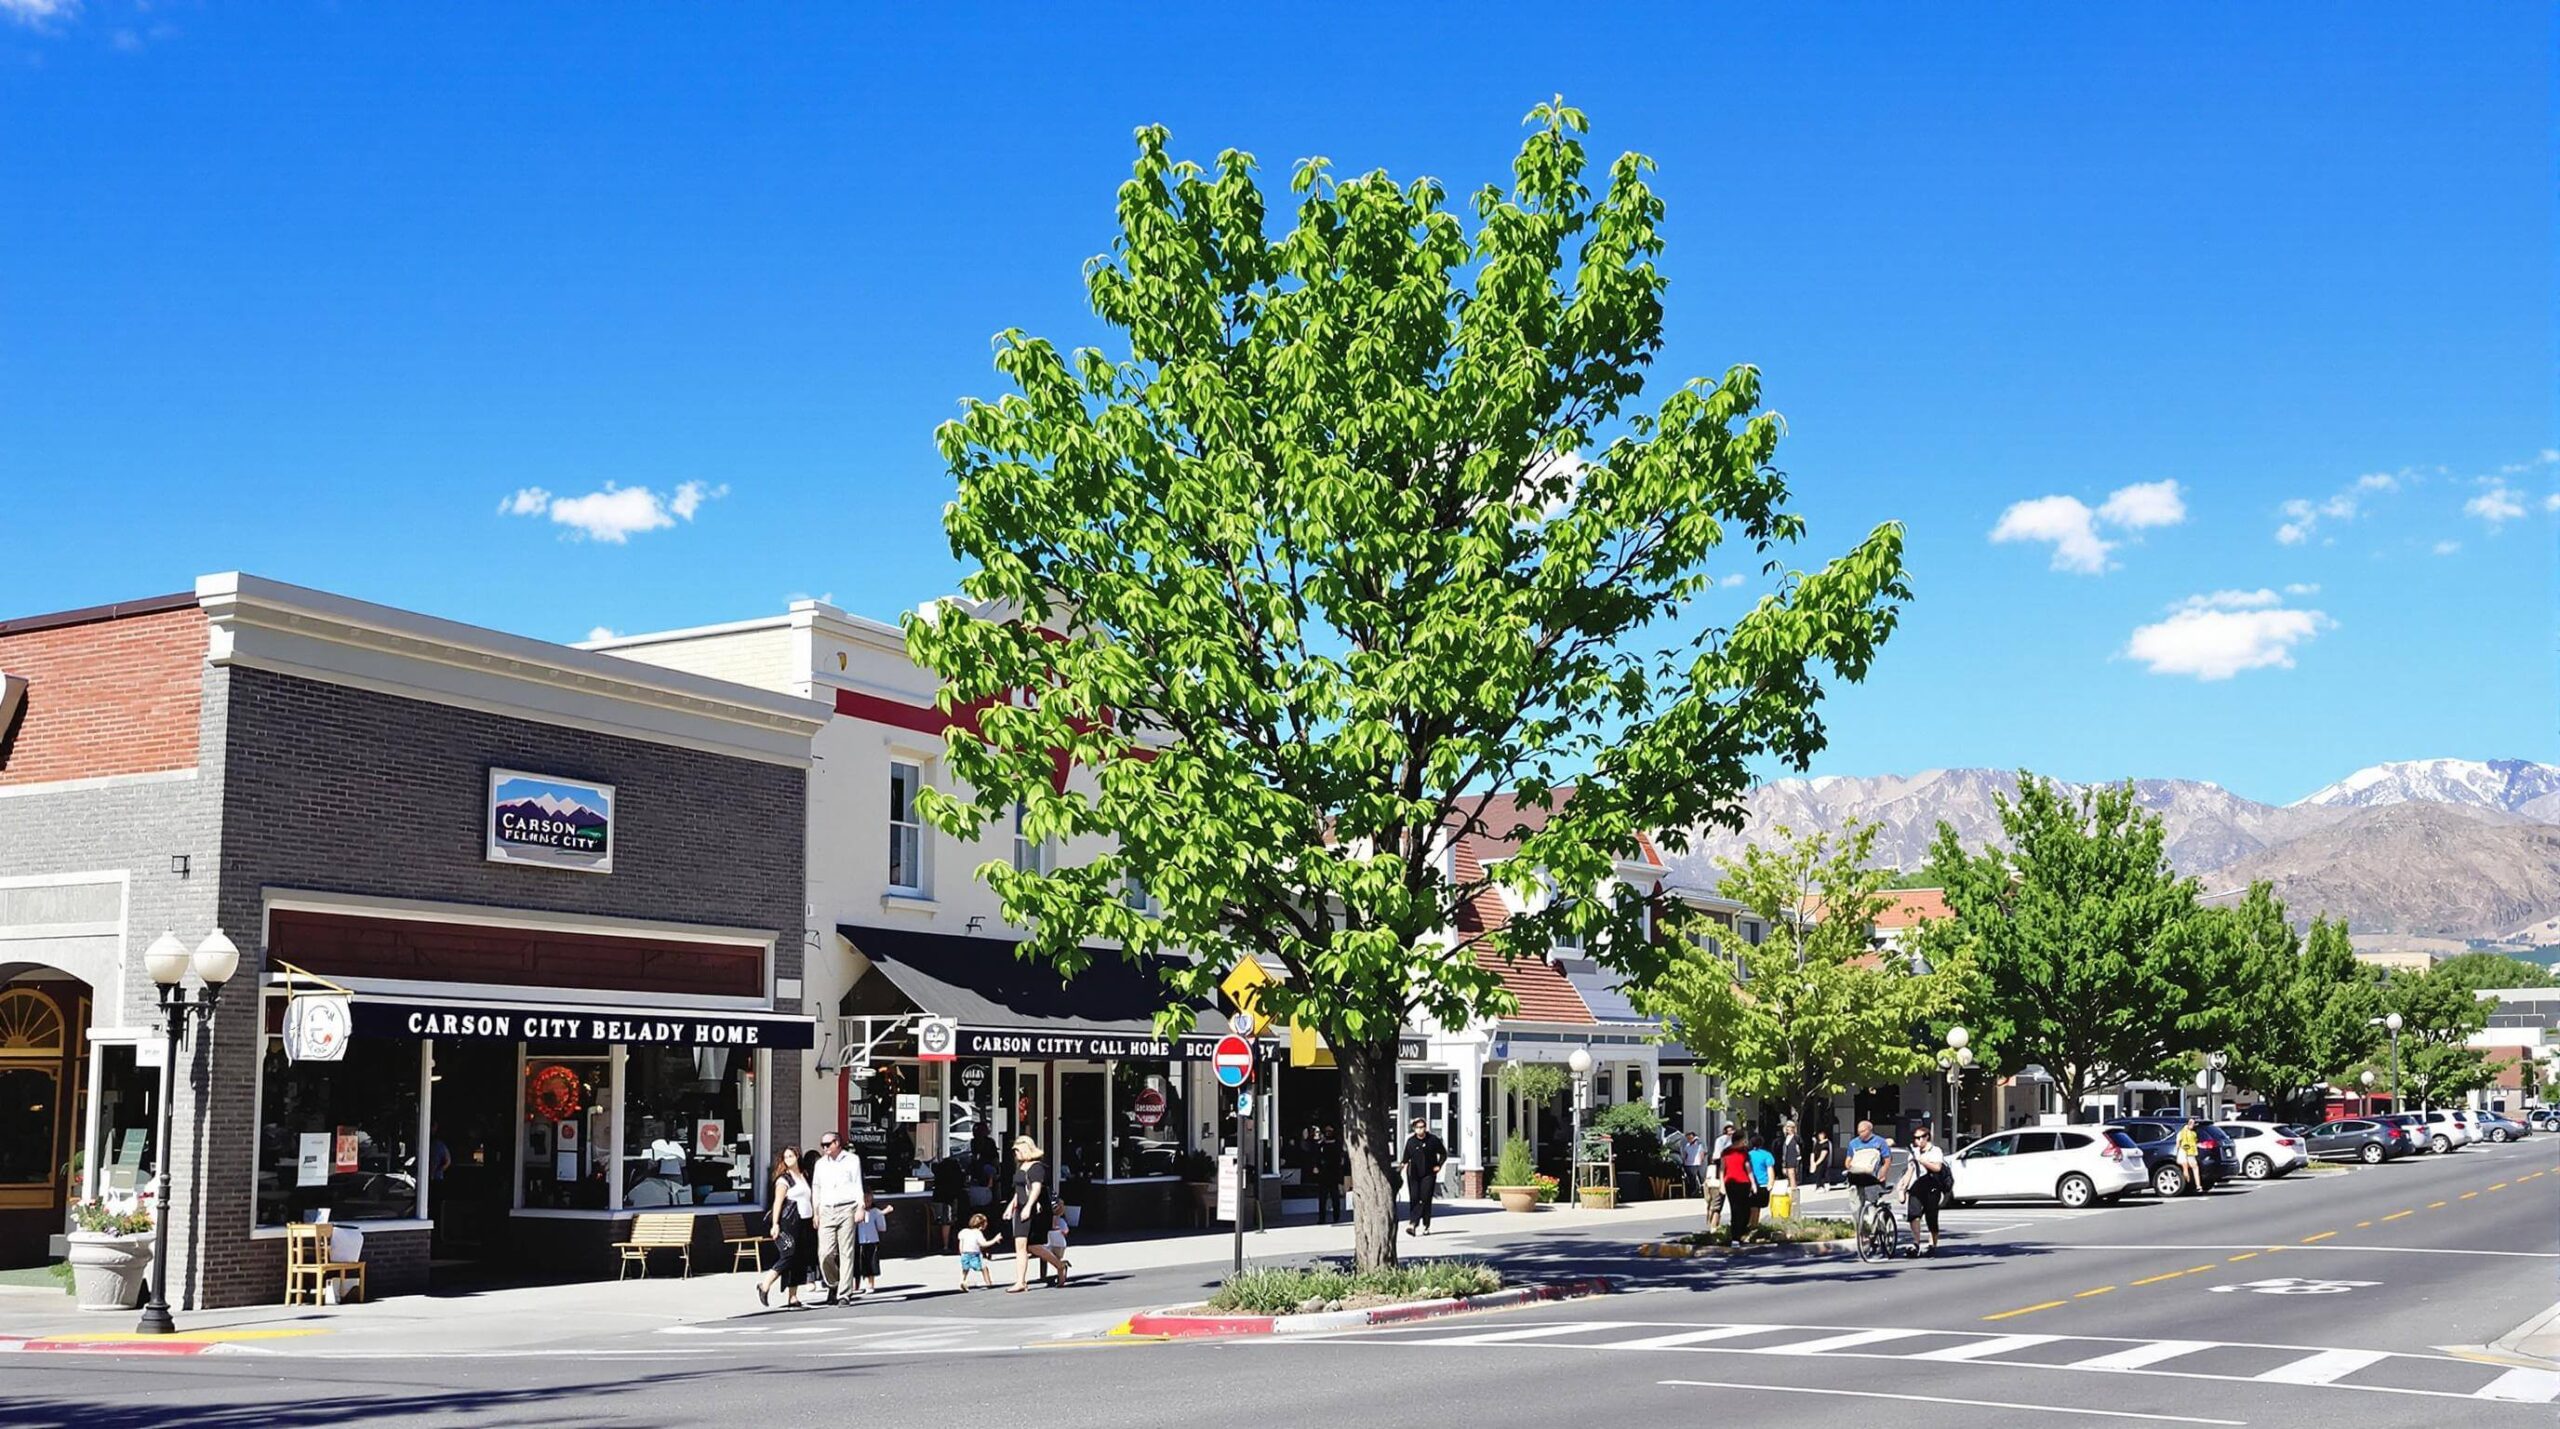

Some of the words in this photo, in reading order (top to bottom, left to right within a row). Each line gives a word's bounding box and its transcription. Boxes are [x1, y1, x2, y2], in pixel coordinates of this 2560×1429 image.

[502, 812, 576, 835] CARSON
[563, 835, 595, 848] CITY
[408, 1012, 510, 1036] CARSON
[523, 1017, 581, 1038] CITY
[592, 1020, 685, 1042] BELADY
[695, 1023, 759, 1044] HOME
[972, 1035, 1031, 1052] CARSON
[1037, 1037, 1084, 1054] CITTY
[1090, 1039, 1126, 1055] CALL
[1130, 1041, 1170, 1056] HOME
